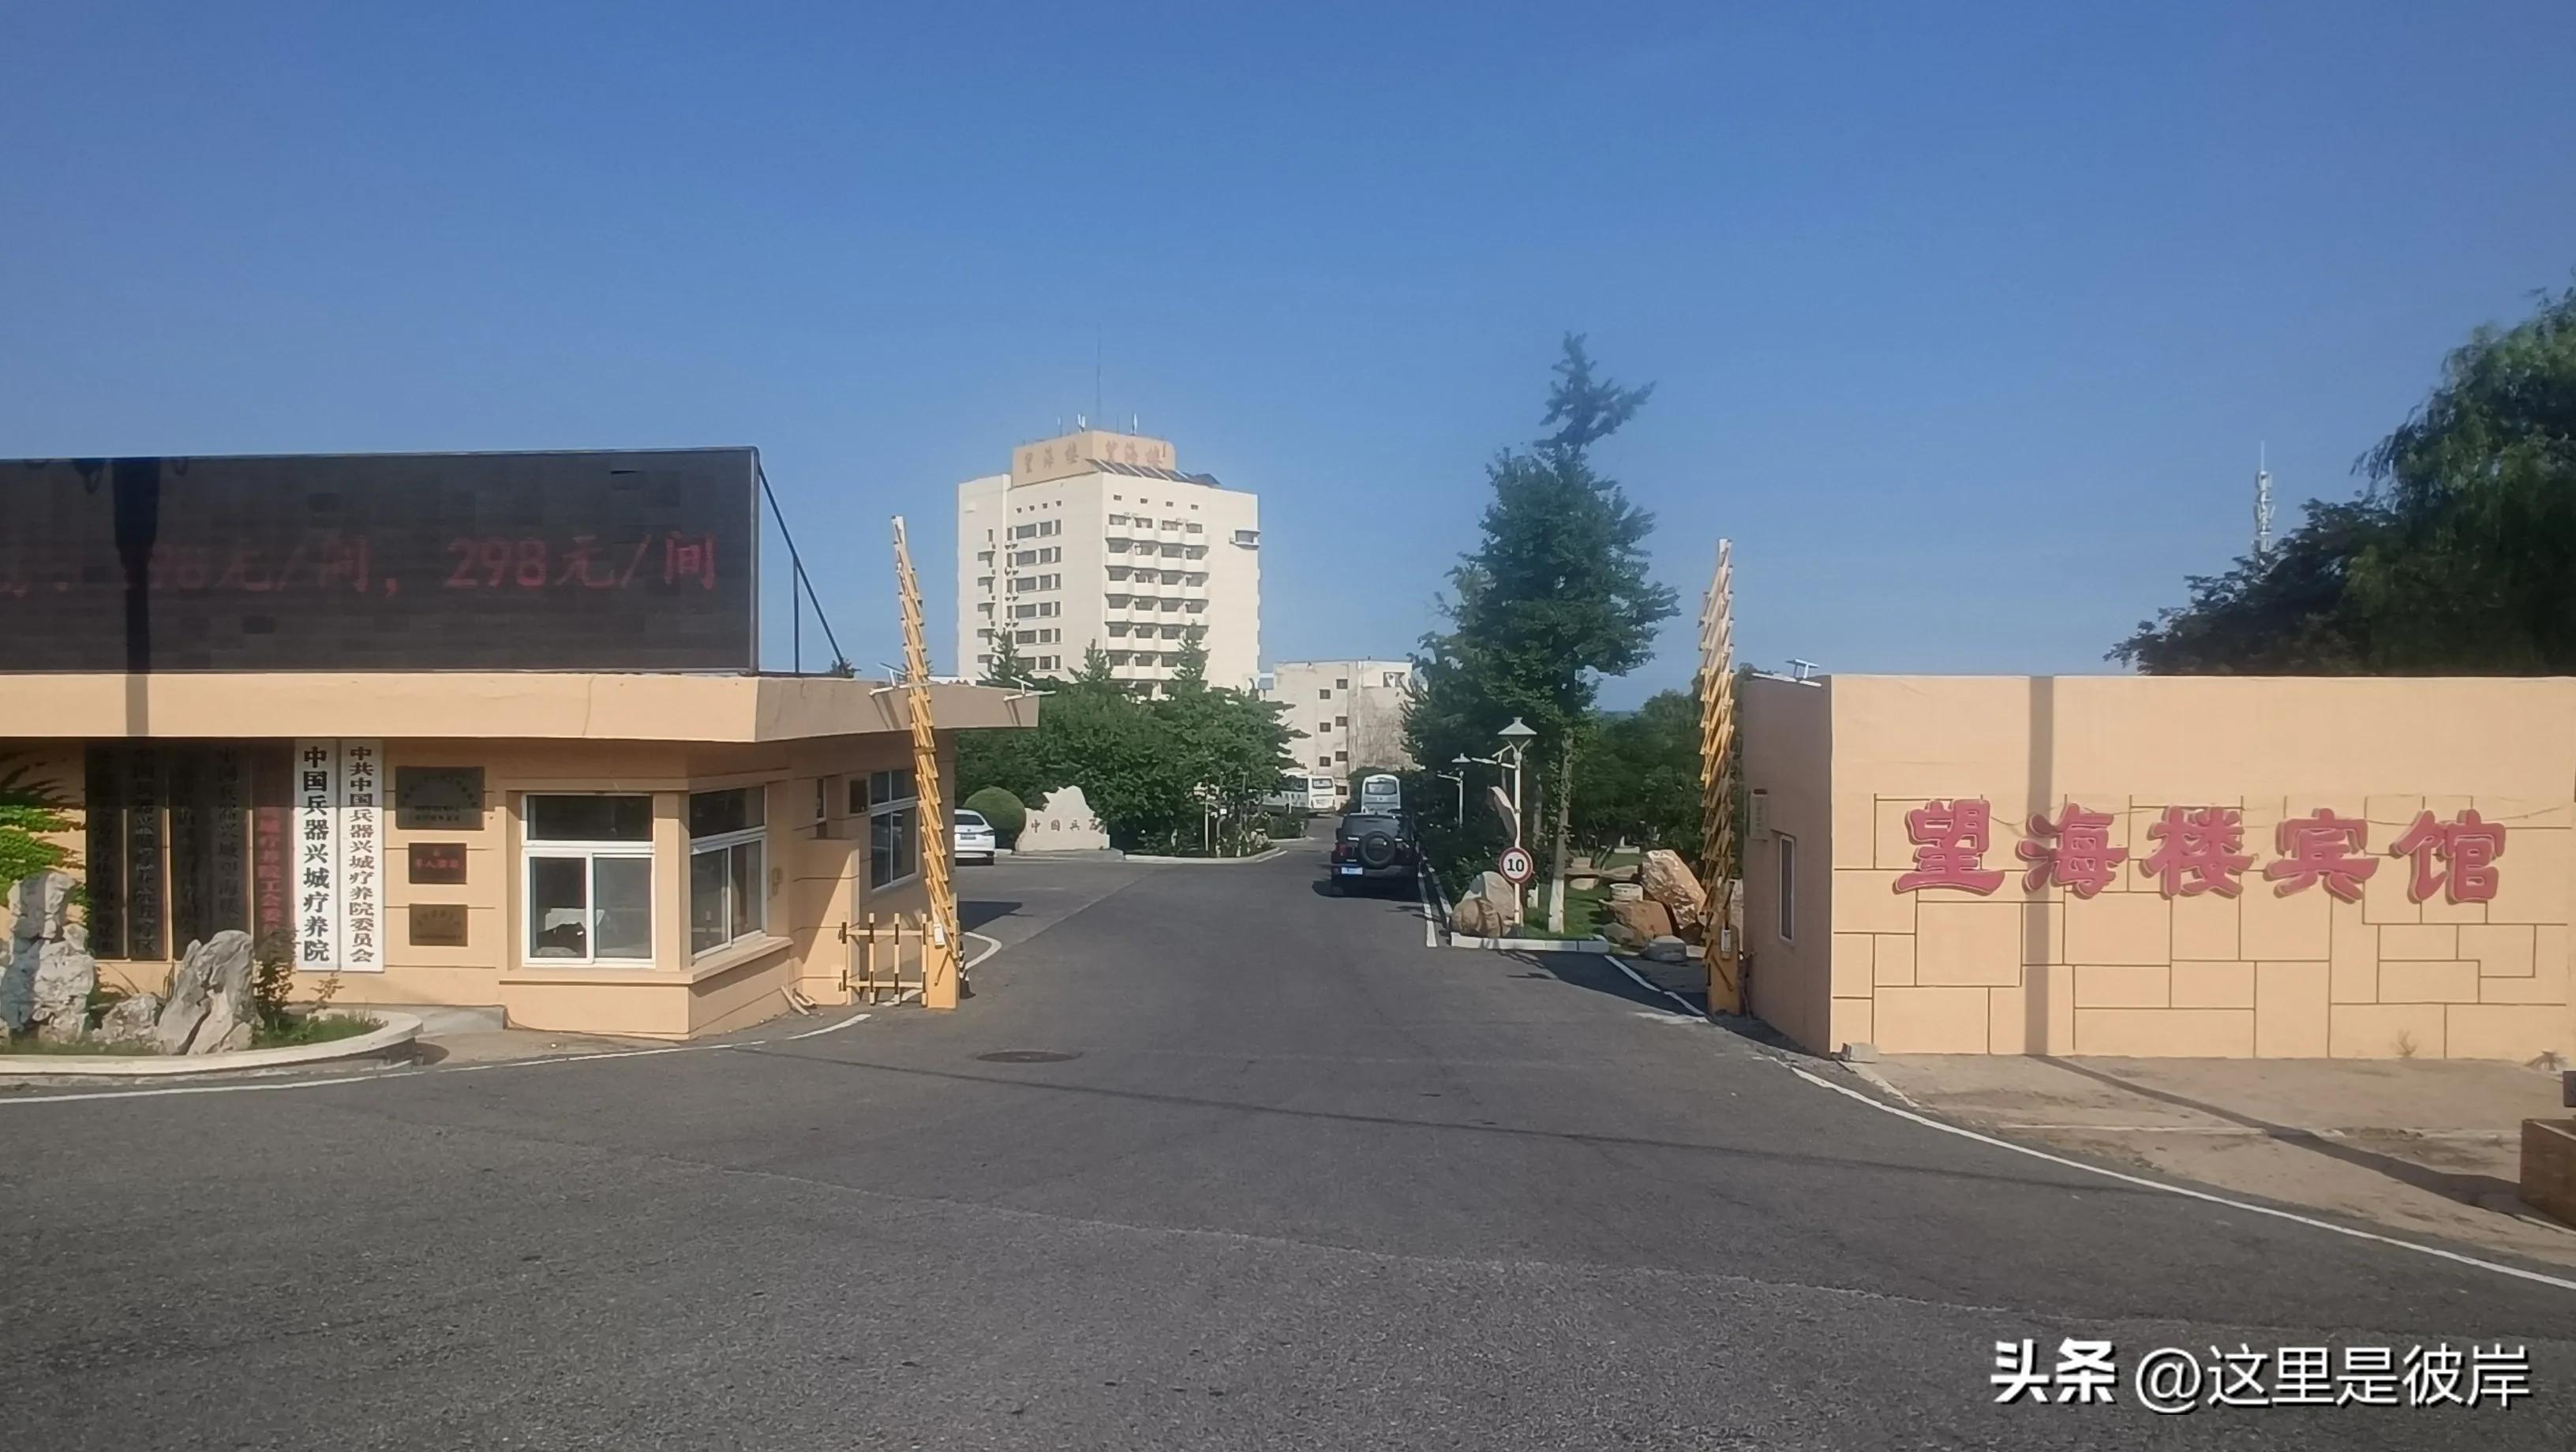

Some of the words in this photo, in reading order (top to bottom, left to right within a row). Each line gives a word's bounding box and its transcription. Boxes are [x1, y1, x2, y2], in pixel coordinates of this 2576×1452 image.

[303, 746, 330, 963] 中国兵器兴城疗养院
[349, 746, 375, 963] 中共中国兵器兴城疗养院委员会
[1507, 858, 1525, 872] 10
[1893, 799, 2507, 904] 望海楼宾馆
